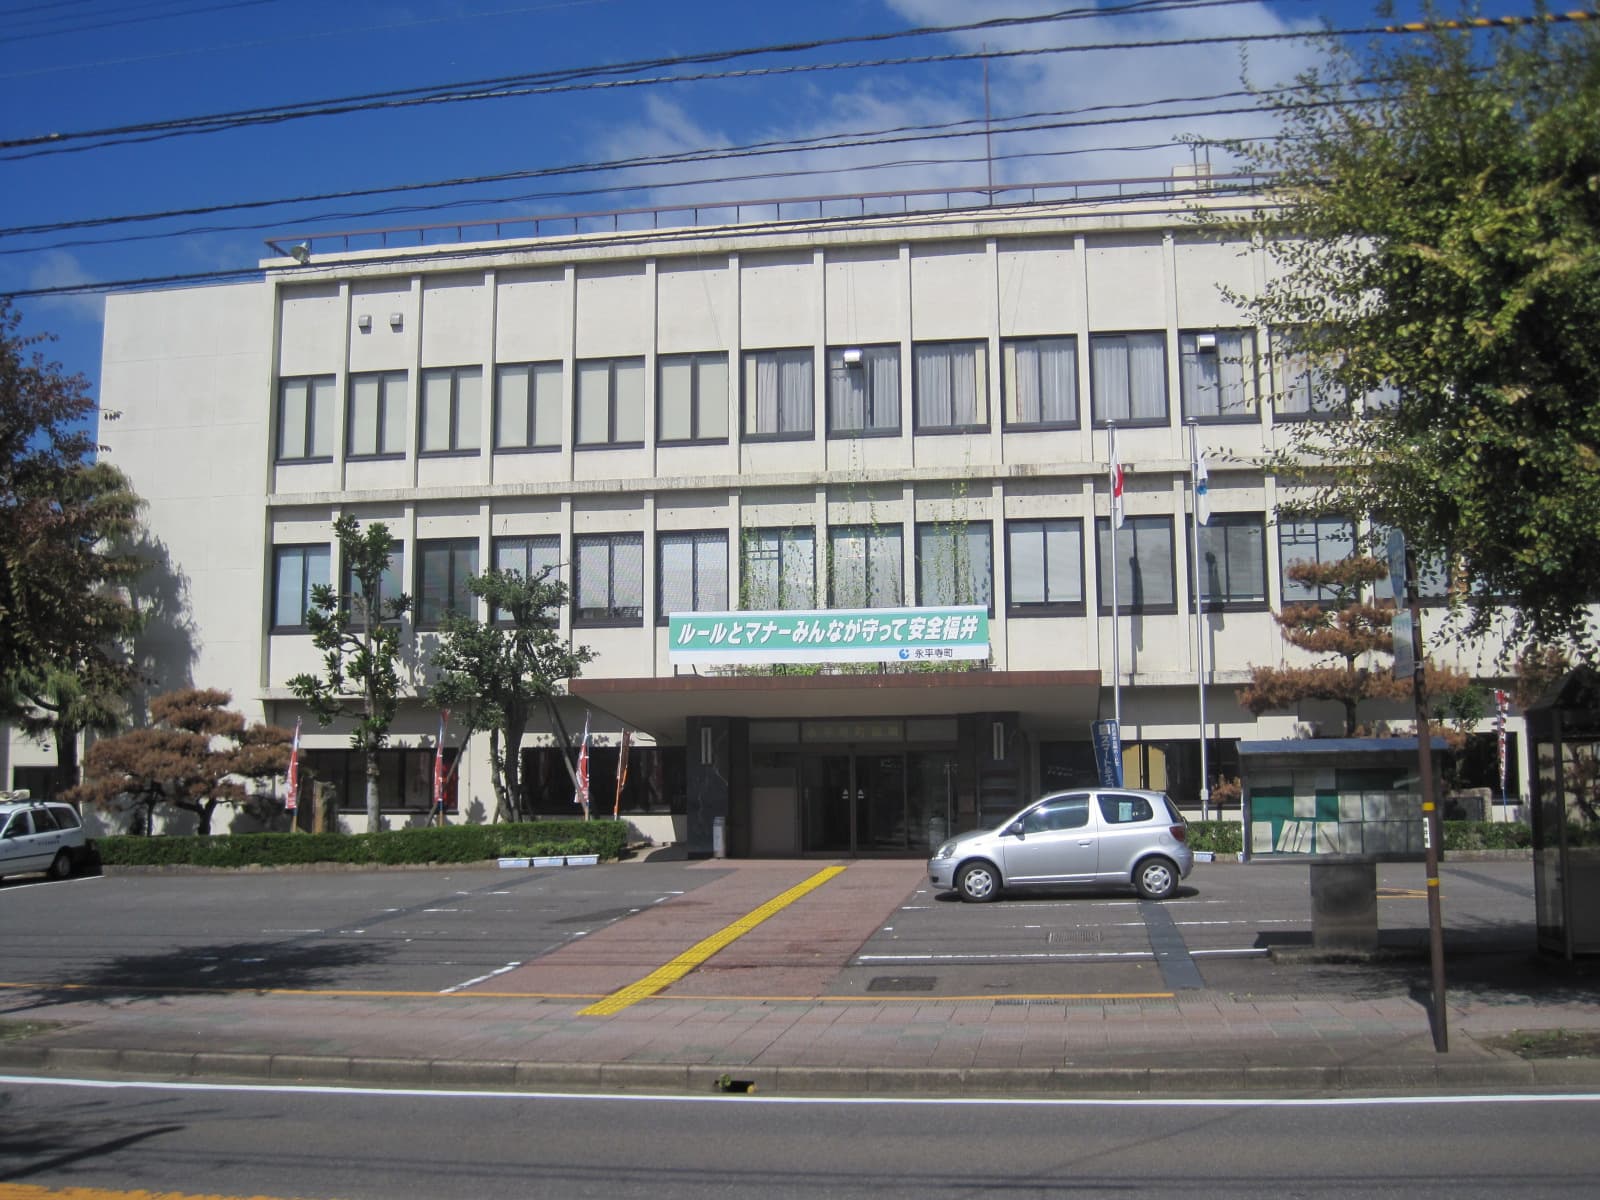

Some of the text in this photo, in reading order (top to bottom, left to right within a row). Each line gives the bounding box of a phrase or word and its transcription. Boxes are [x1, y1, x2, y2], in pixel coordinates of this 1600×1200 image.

[677, 614, 979, 645] ルールとマナーみんなが守って安全福井
[914, 647, 953, 659] 永平寺町
